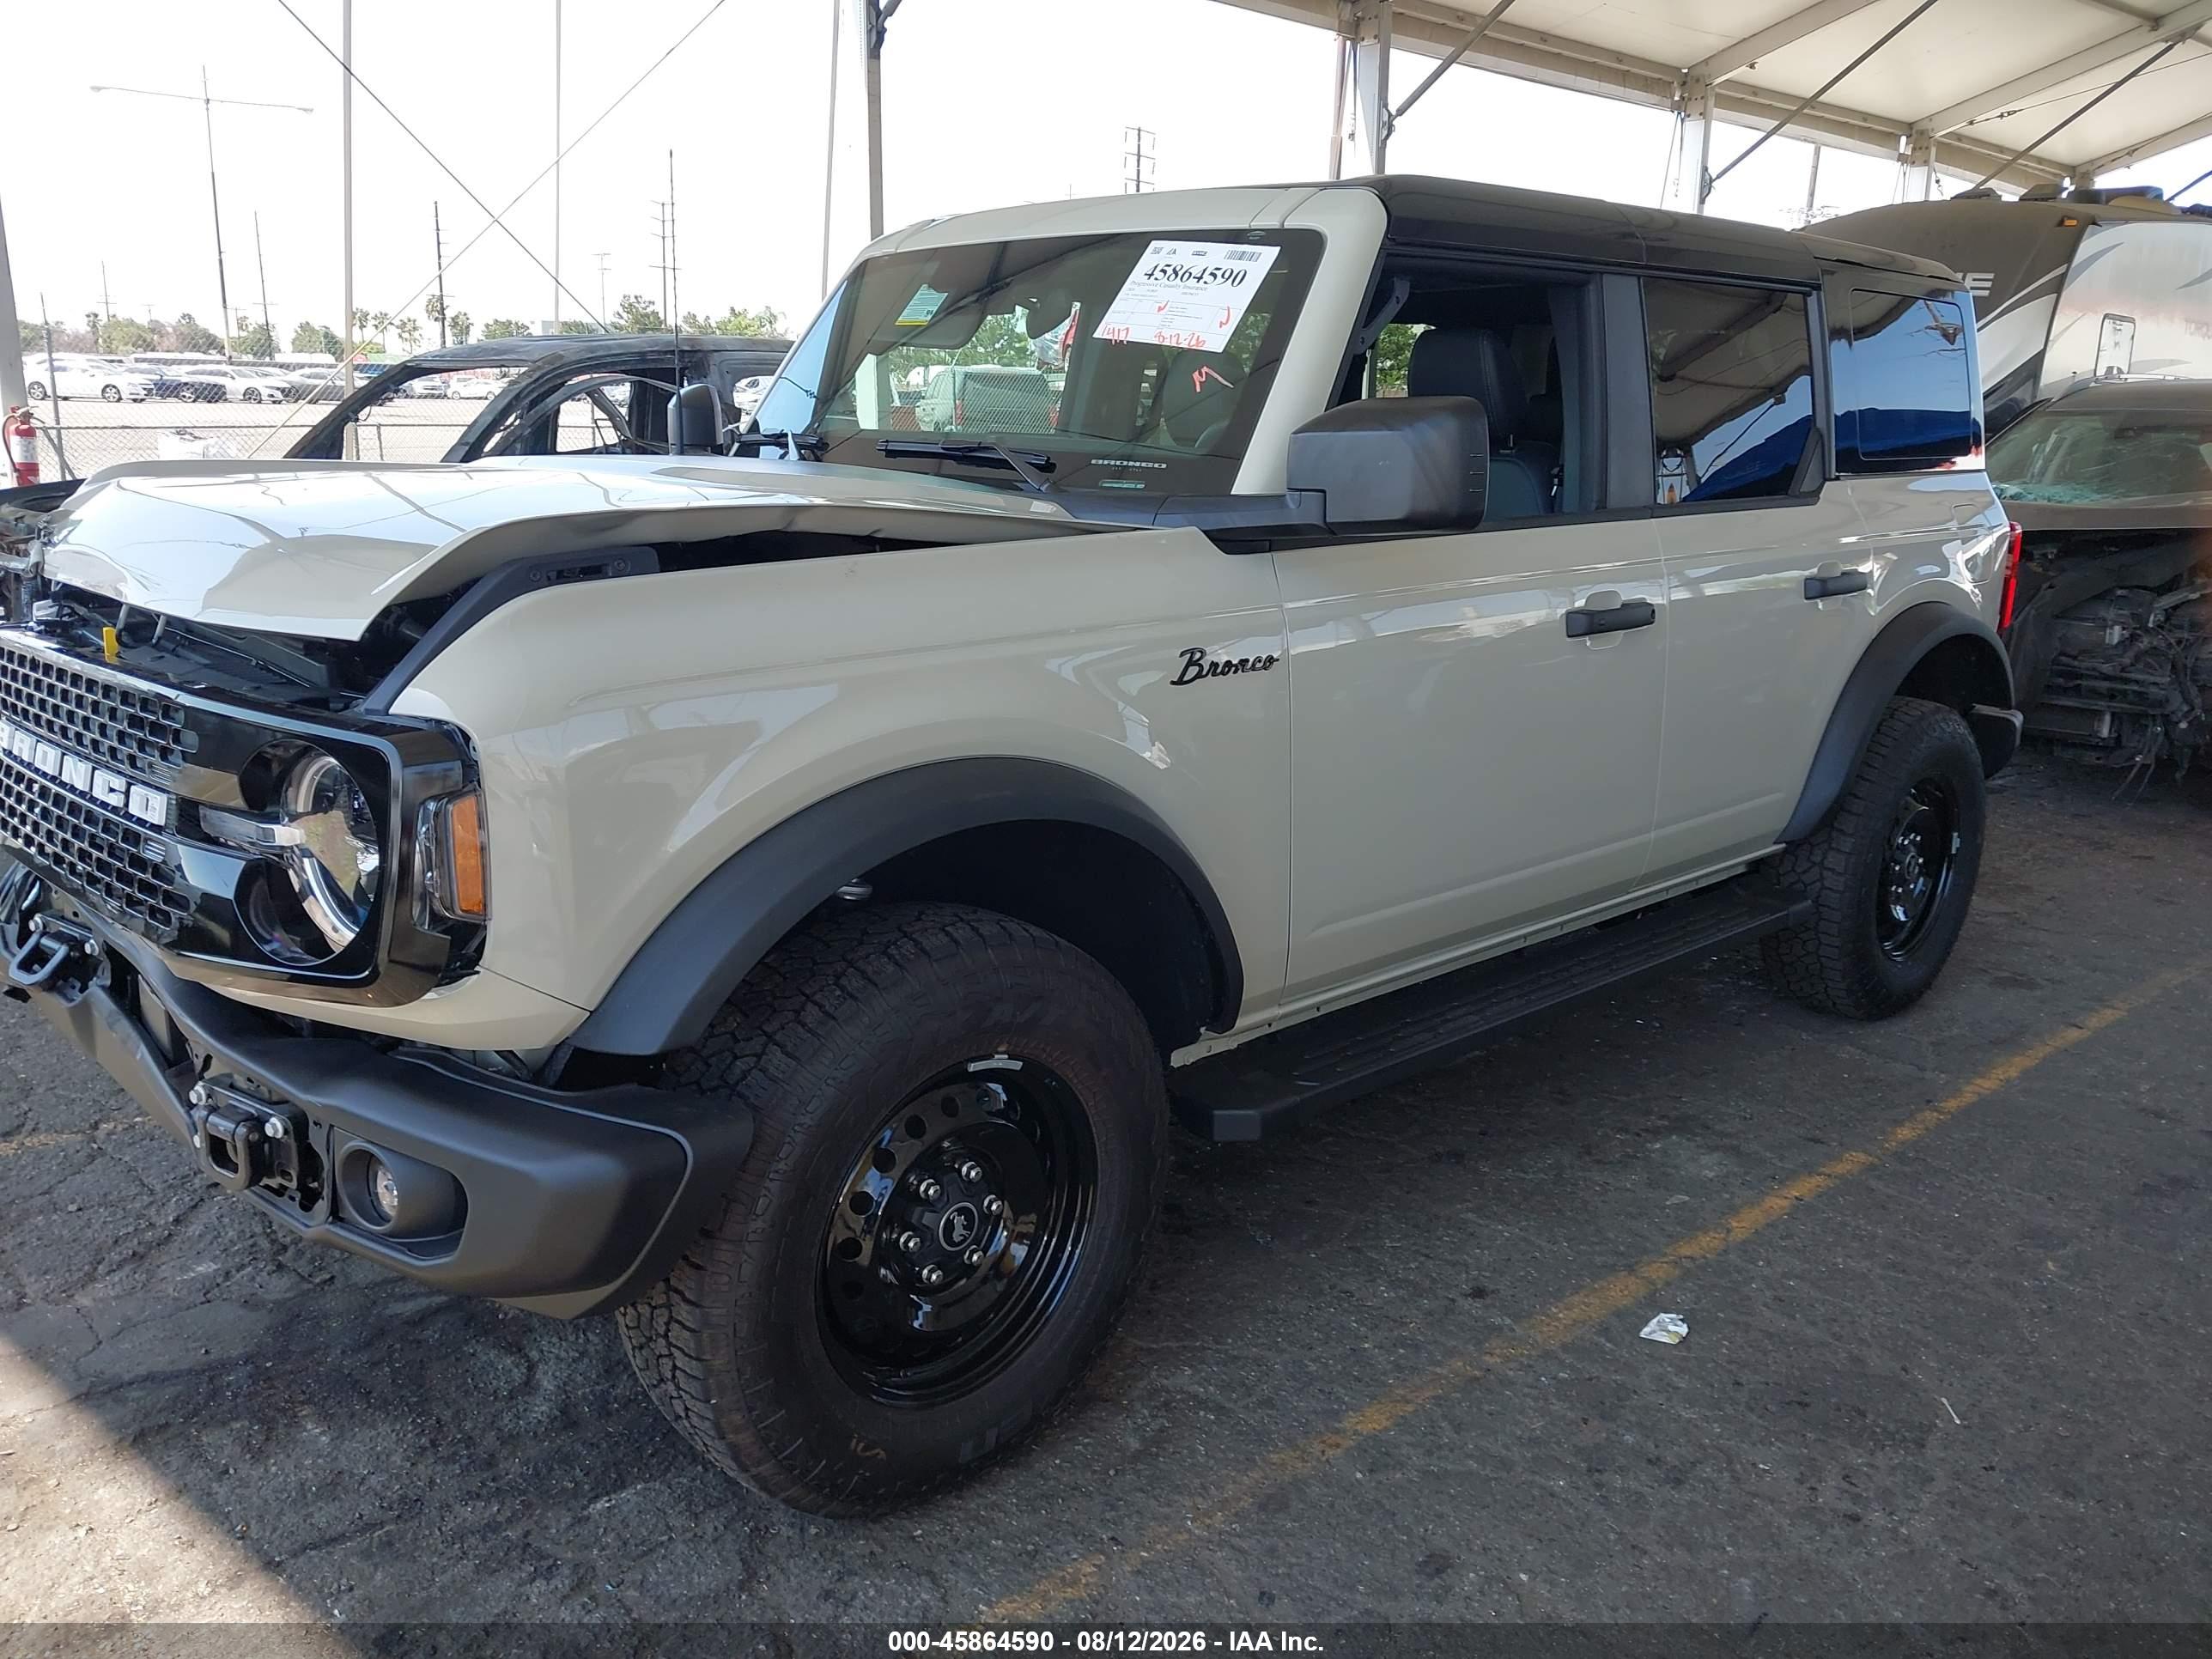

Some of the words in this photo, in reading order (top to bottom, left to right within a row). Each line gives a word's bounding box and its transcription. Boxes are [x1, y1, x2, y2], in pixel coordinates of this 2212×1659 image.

[1144, 263, 1248, 288] 45864590
[1091, 459, 1167, 469] BRONCO
[1170, 647, 1279, 686] Bronco
